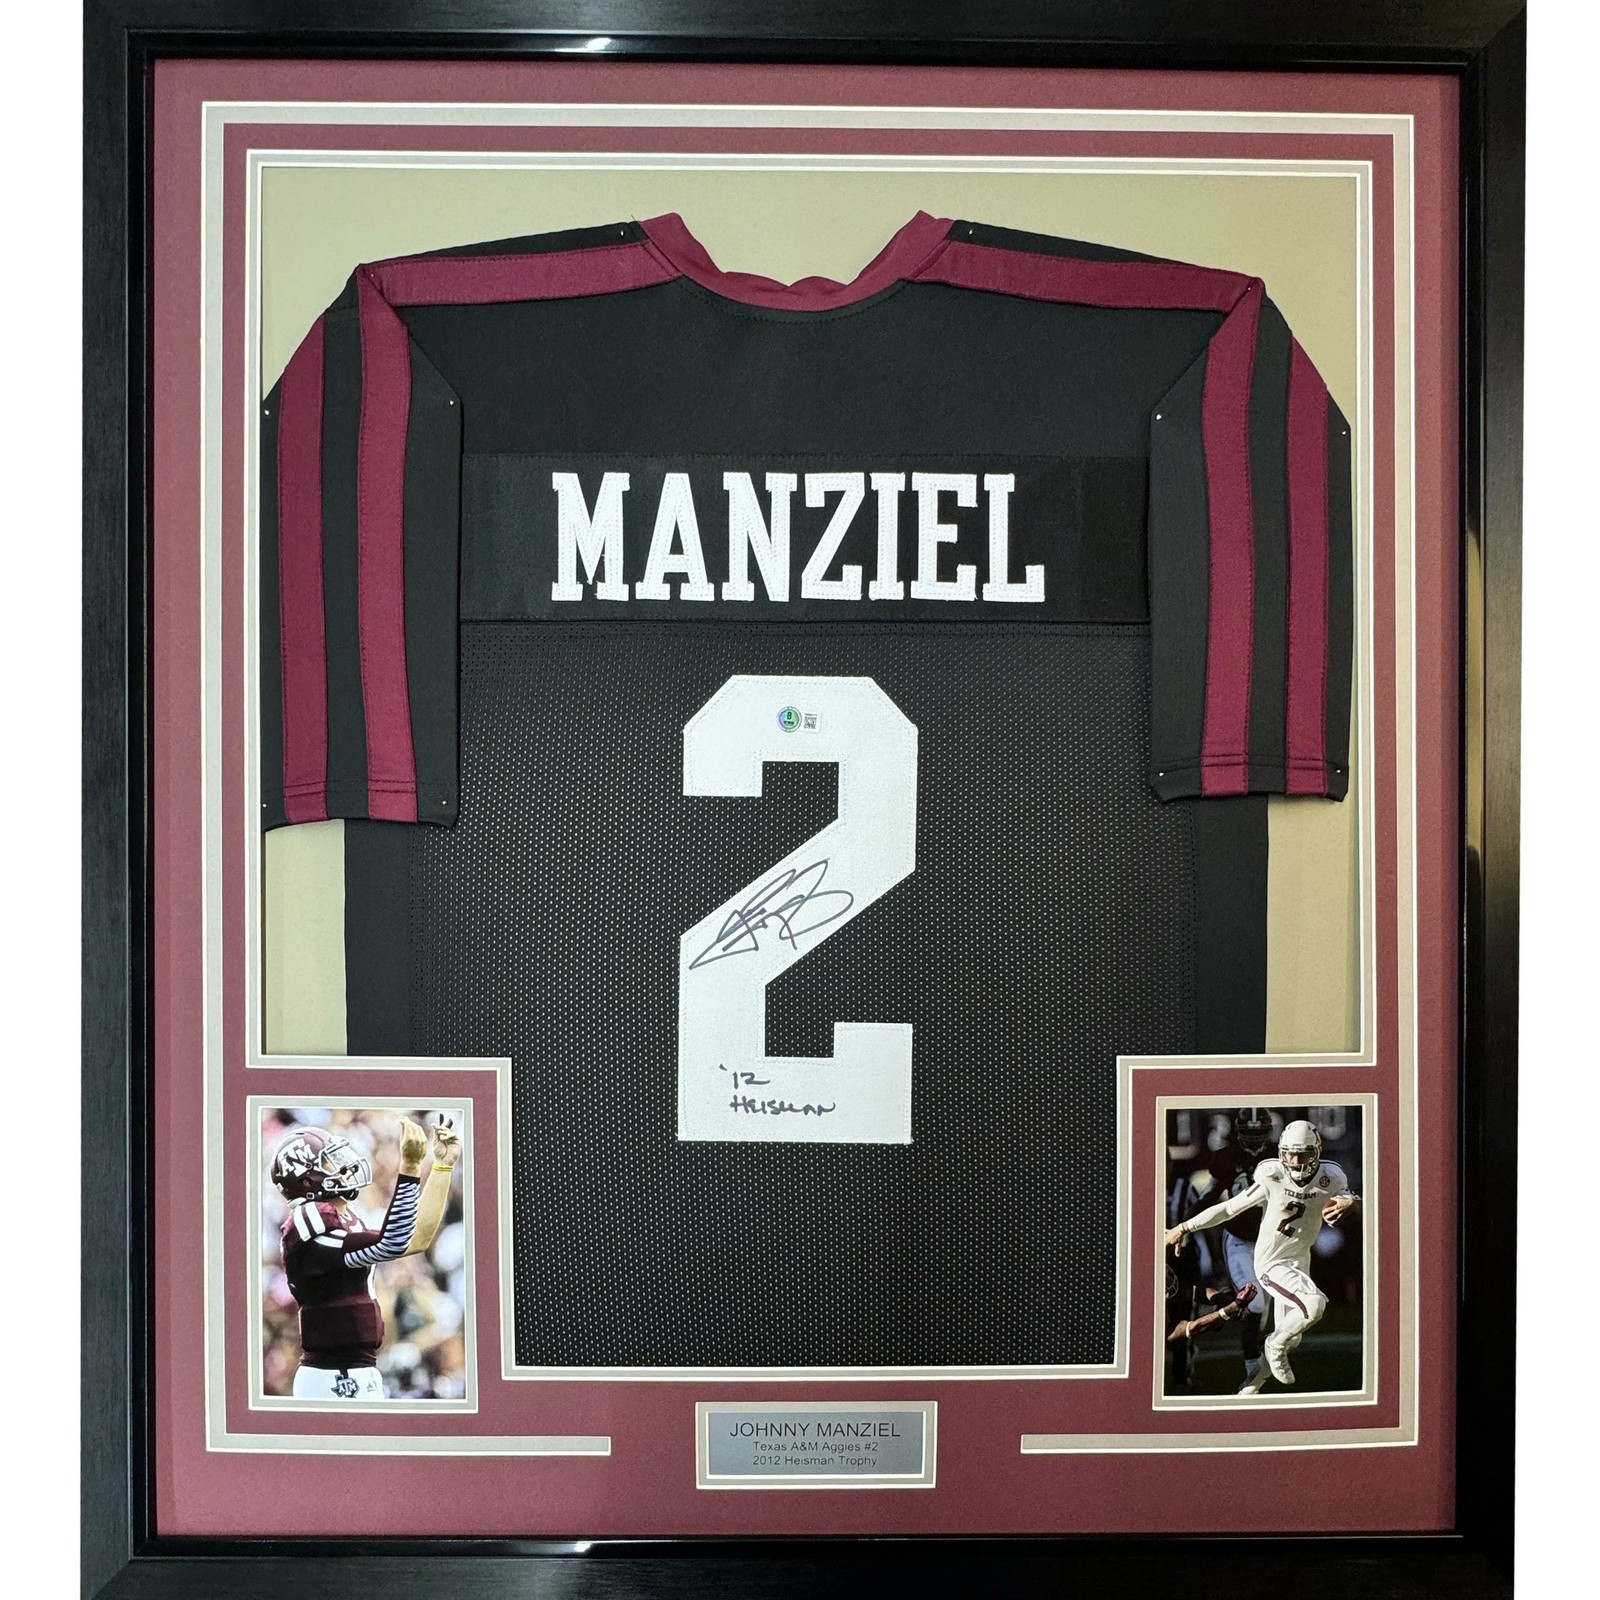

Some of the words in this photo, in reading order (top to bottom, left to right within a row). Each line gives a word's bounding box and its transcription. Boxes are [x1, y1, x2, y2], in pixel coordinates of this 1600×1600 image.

[551, 471, 1046, 603] MANZIEL
[678, 674, 919, 1145] 2
[1276, 1200, 1307, 1238] 2
[729, 1422, 810, 1437] JOHNNY
[816, 1422, 901, 1437] MANZIEL
[752, 1441, 787, 1451] Texas
[790, 1441, 818, 1451] A&M
[821, 1441, 861, 1454] Aggies
[864, 1441, 879, 1451] #2
[752, 1455, 781, 1466] 2012
[784, 1455, 834, 1466] Heisman
[838, 1455, 878, 1467] Trophy
